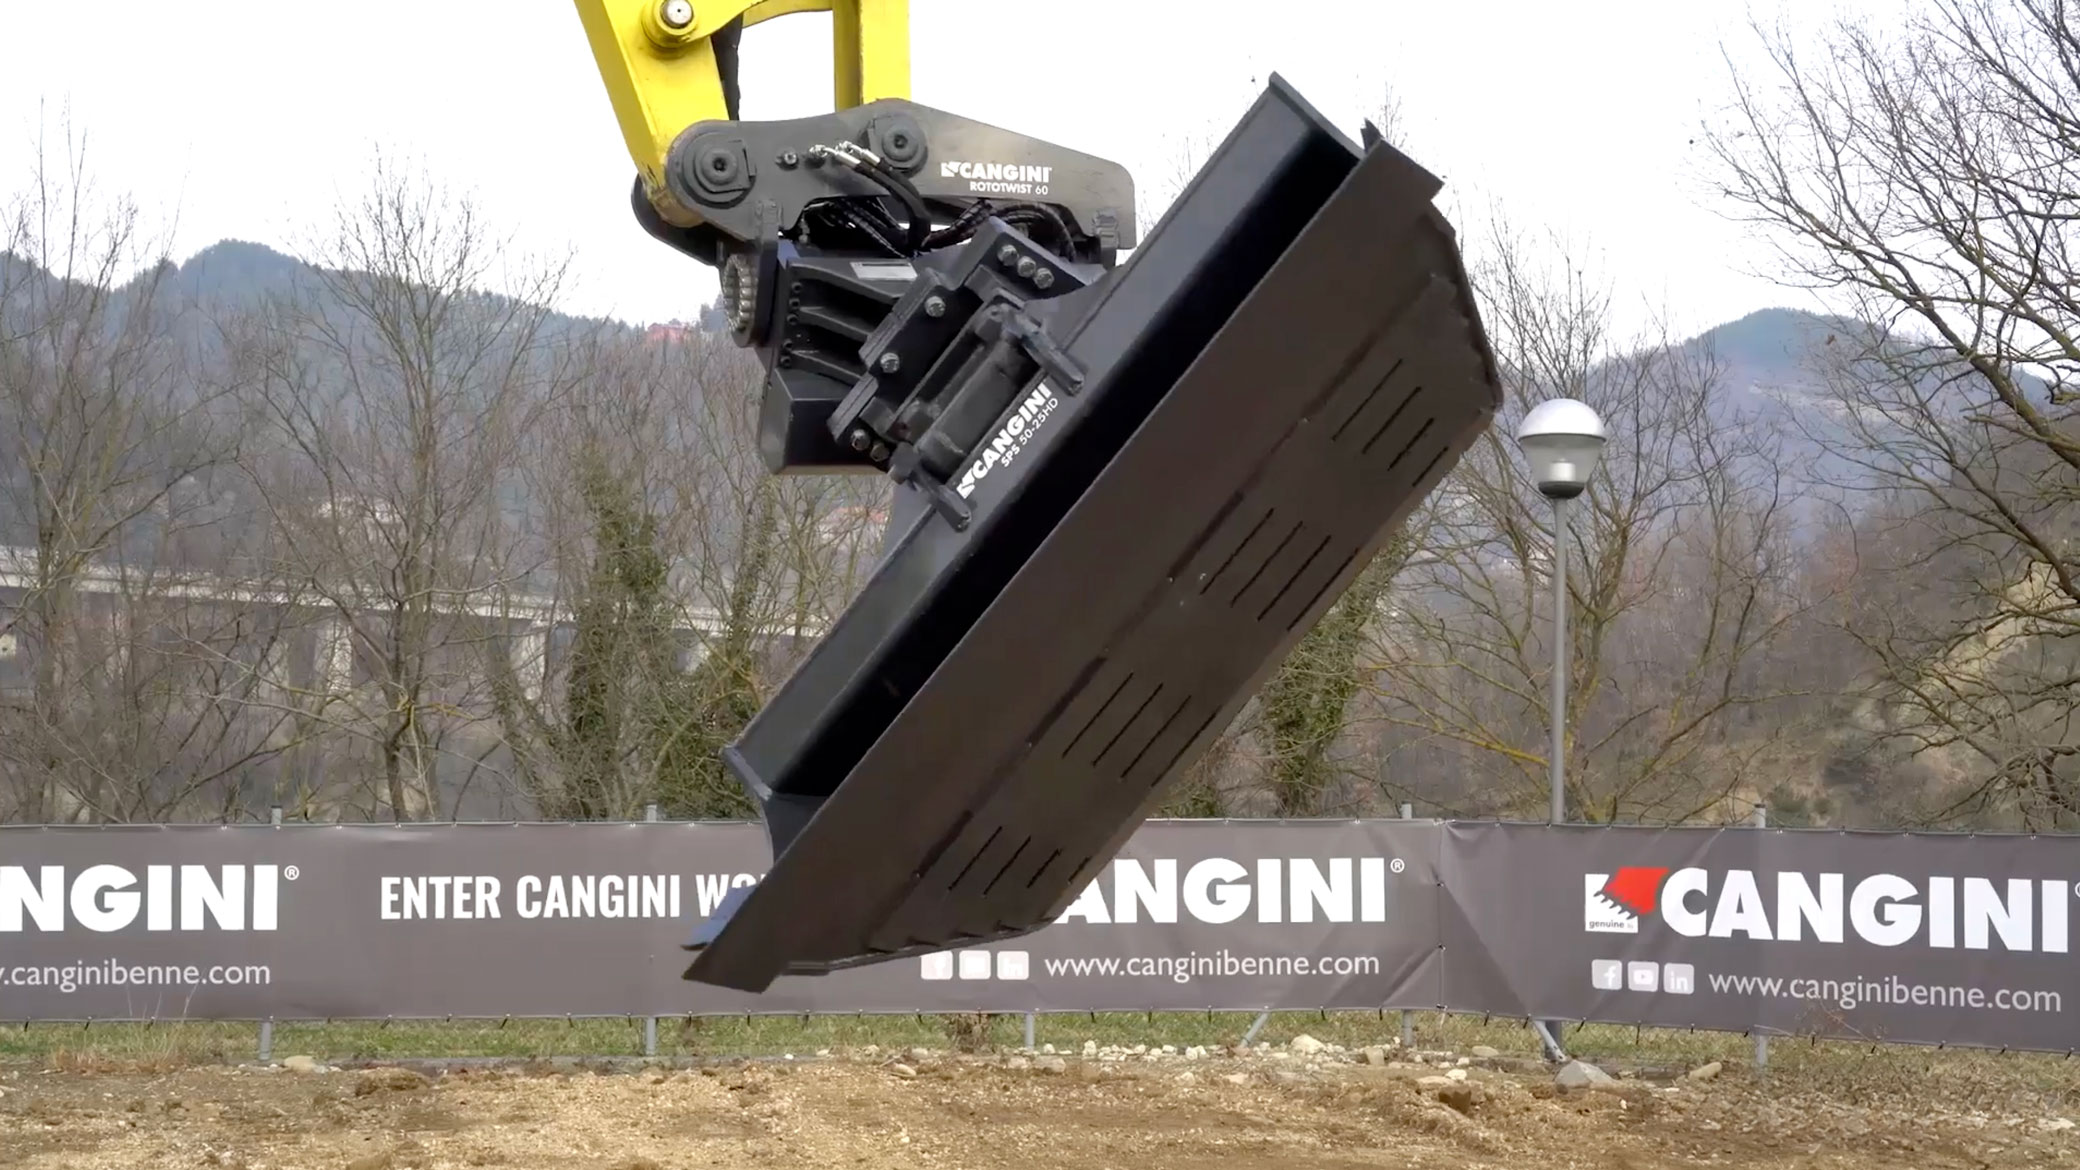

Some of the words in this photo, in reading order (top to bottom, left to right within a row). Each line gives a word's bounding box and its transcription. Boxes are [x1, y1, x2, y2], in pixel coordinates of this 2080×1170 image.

[960, 162, 1049, 183] CANGINI
[970, 181, 1032, 194] ROTOTWIST
[1035, 185, 1049, 195] 60
[972, 382, 1052, 479] CANGINI
[1001, 444, 1021, 467] SPS
[1019, 397, 1058, 445] 50-25HD
[381, 876, 501, 919] ENTER
[516, 875, 680, 918] CANGINI
[1052, 858, 1386, 924] ANGINI
[1661, 867, 2068, 953] CANGINI
[1589, 920, 1625, 929] genuine
[1044, 949, 1379, 983] www.canginibenne.com
[1708, 973, 2061, 1012] www.canginibenne.com
